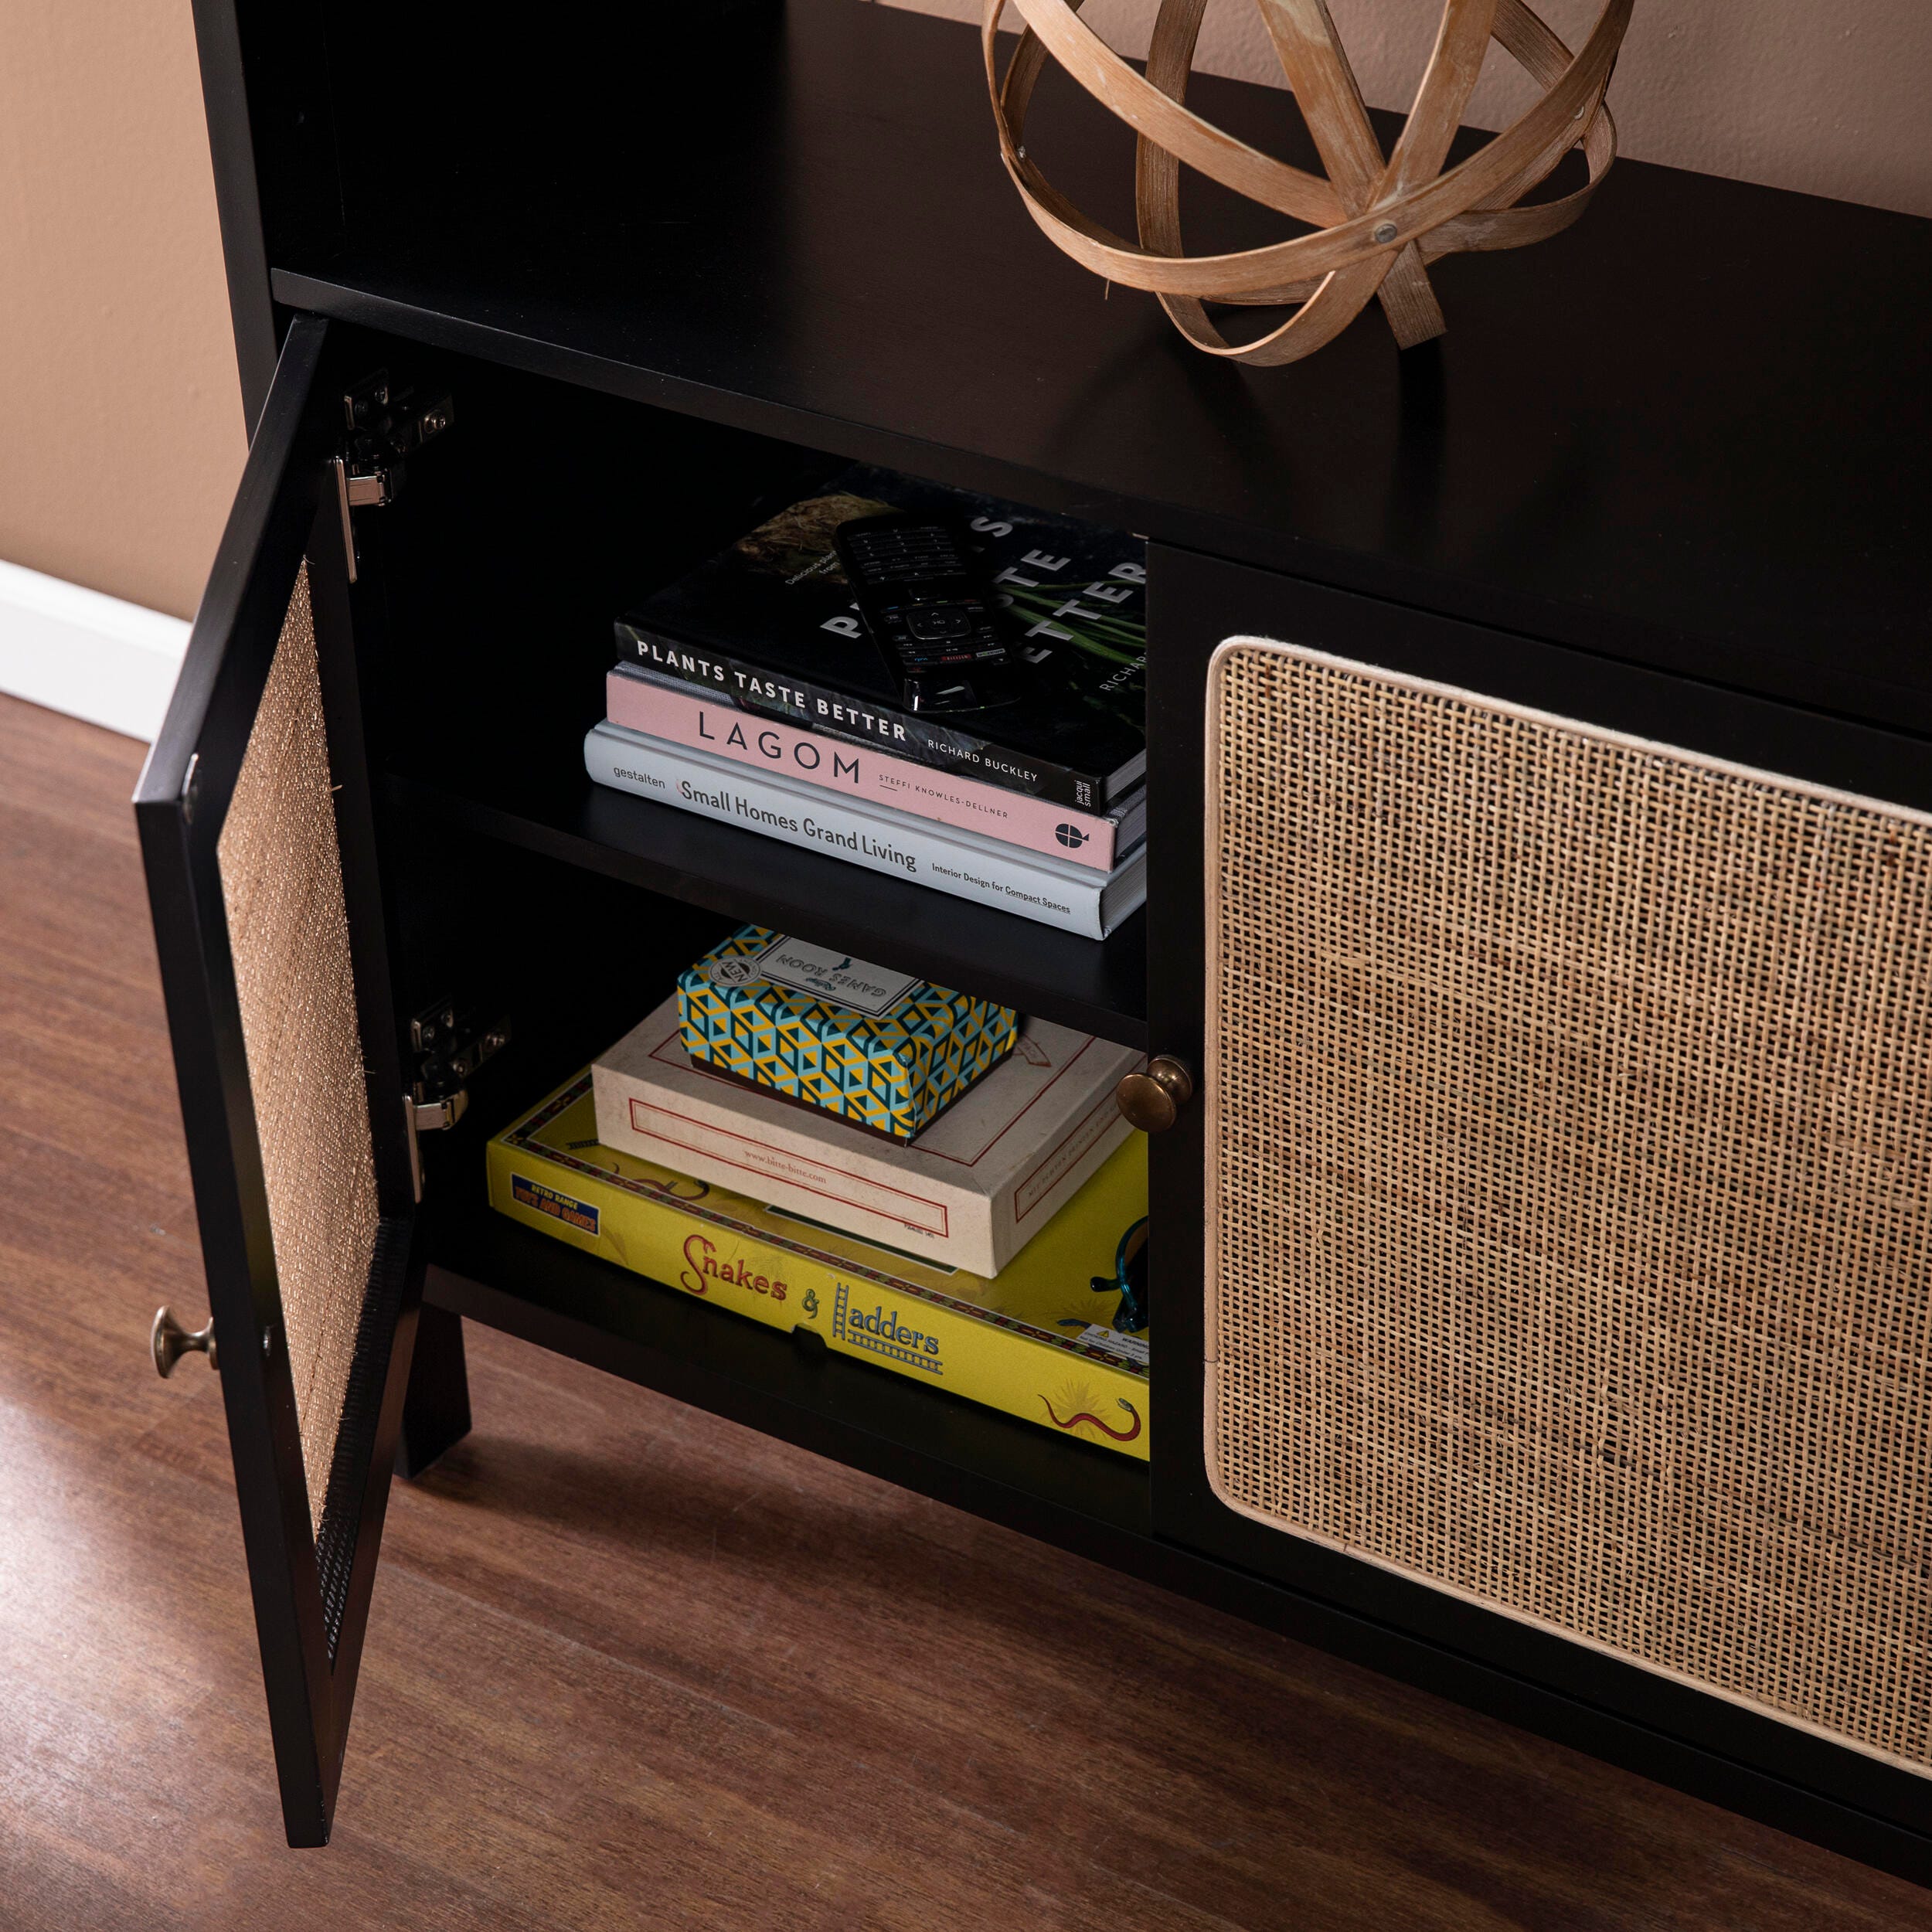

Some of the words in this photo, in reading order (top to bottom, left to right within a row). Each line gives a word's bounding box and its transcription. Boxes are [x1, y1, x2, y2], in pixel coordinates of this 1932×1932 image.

[1016, 562, 1147, 664] ETTER
[637, 640, 725, 682] PLANTS
[734, 672, 805, 709] TASTE
[817, 698, 906, 741] BETTER
[1099, 653, 1148, 692] RICHAR
[699, 711, 859, 784] LAGOM
[927, 739, 980, 764] RICHARD
[985, 757, 1039, 783] BUCKLEY
[614, 767, 665, 789] gestalten
[879, 774, 910, 789] STEFFI
[915, 785, 1008, 818] KNOWLES-DELLNER
[1073, 780, 1084, 805] jacqui
[1082, 782, 1091, 808] small
[682, 781, 730, 811] Small
[735, 797, 798, 832] Homes
[803, 818, 858, 851] Grand
[862, 835, 917, 872] Living
[932, 863, 961, 879] Interior
[964, 872, 990, 888] Design
[992, 881, 1004, 892] for
[1005, 886, 1041, 904] Compact
[1043, 898, 1071, 914] Spaces
[722, 961, 749, 982] NEW
[776, 954, 828, 977] ROOM
[828, 972, 886, 997] GAMES
[743, 1150, 827, 1184] www.bitte-bitte.com
[531, 1184, 553, 1199] RETRO
[555, 1194, 578, 1210] RANGE
[680, 1234, 787, 1301] Snakes
[802, 1288, 820, 1319] &
